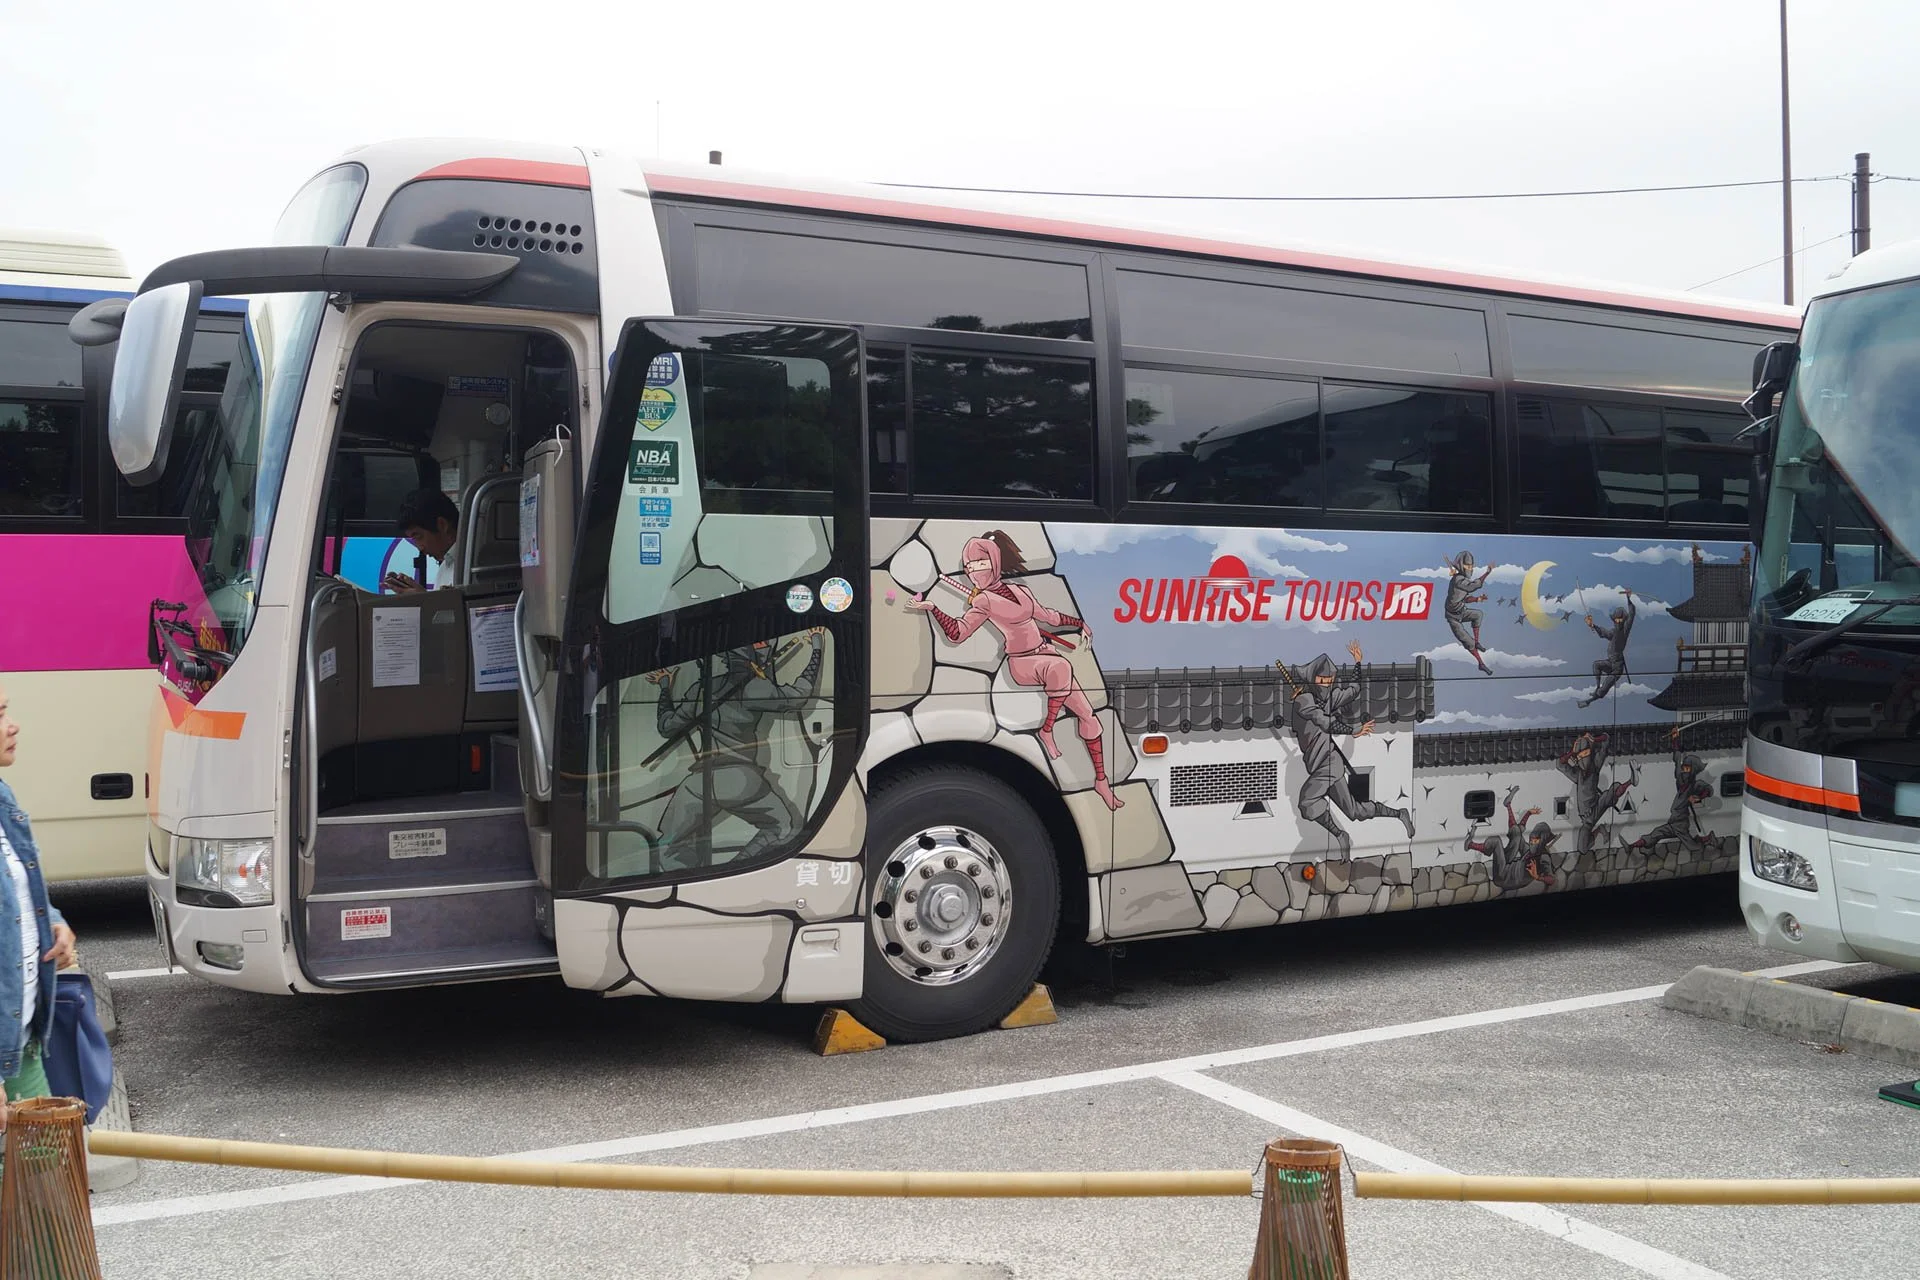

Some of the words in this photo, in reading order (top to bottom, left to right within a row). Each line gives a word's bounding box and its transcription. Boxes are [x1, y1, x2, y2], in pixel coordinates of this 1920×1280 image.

[650, 357, 673, 366] MRI
[644, 412, 660, 420] BUS
[636, 450, 671, 464] NBA
[1113, 577, 1275, 624] SUNRISE
[1284, 580, 1382, 622] TOURS
[1384, 583, 1429, 619] JTB
[796, 861, 851, 887] 貸切
